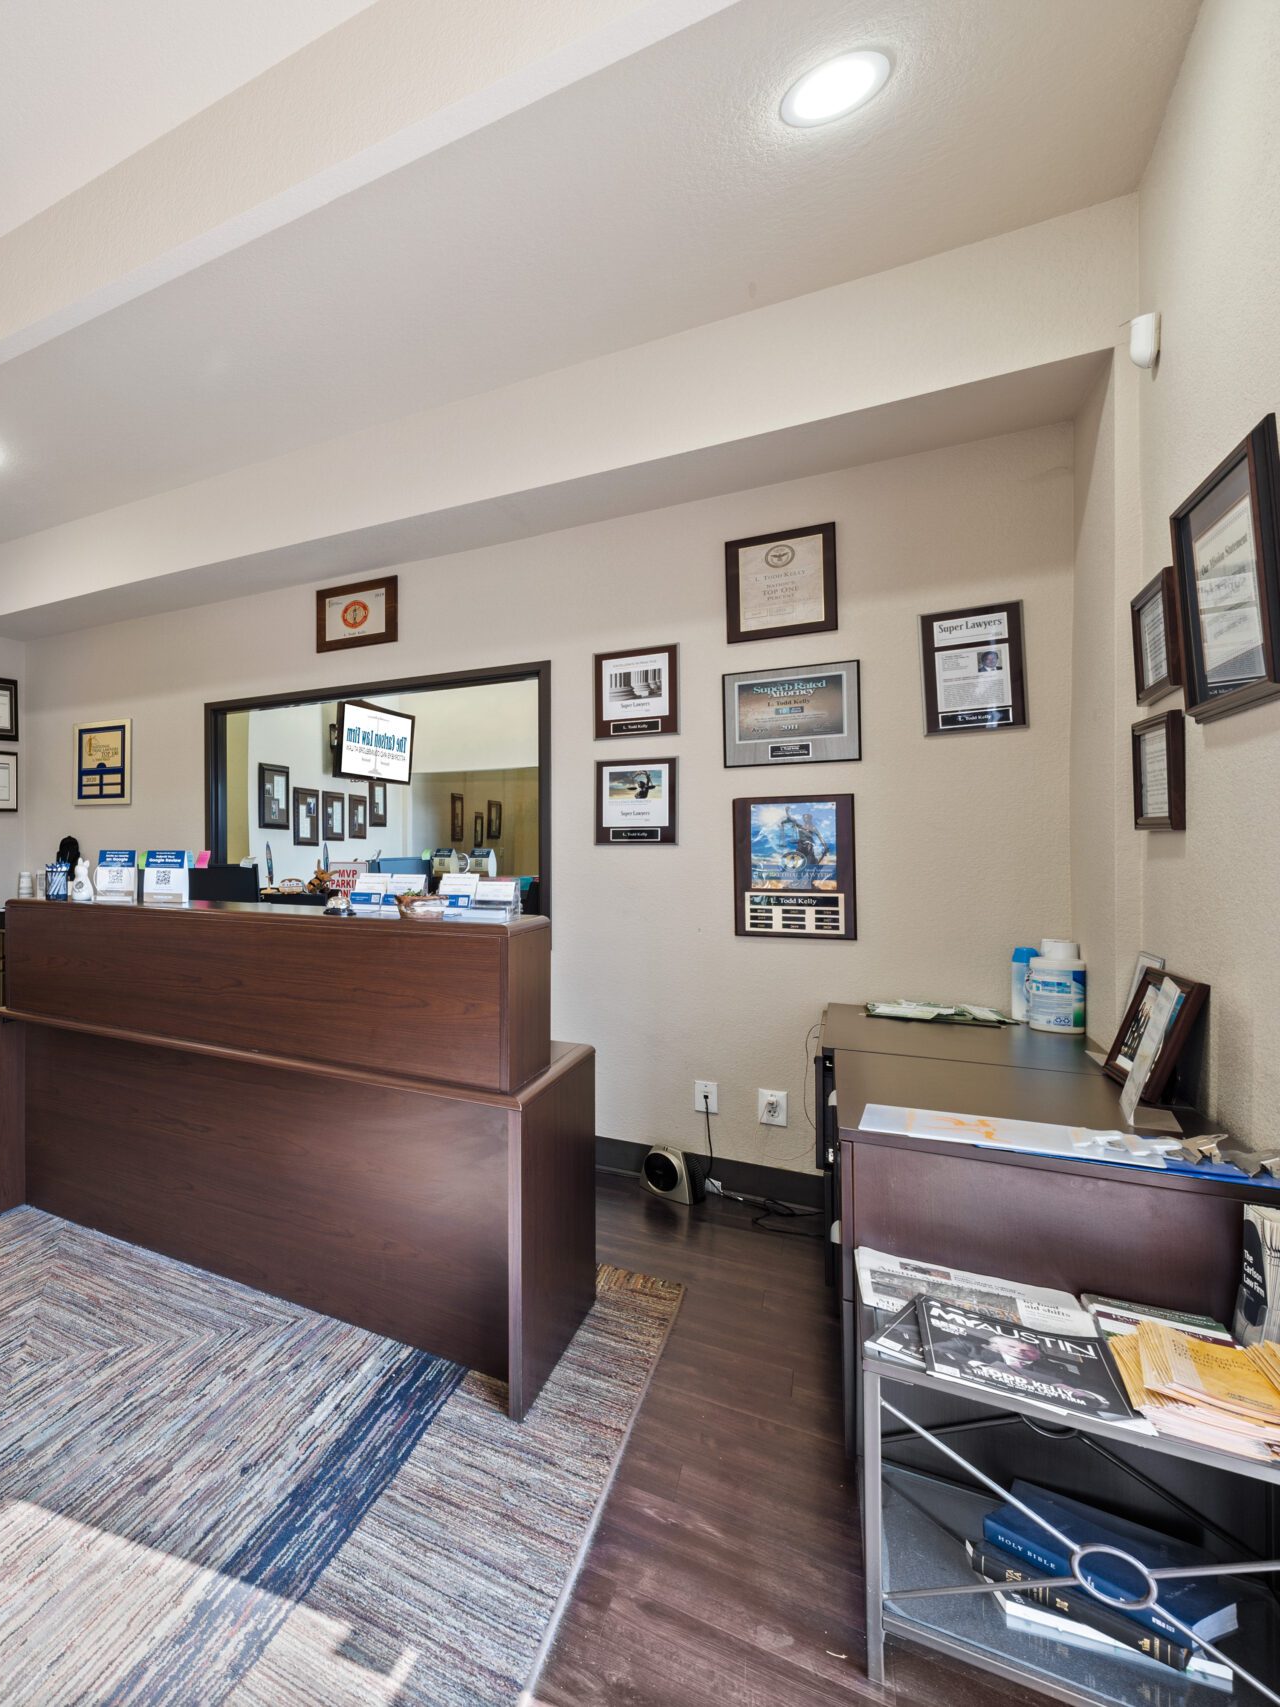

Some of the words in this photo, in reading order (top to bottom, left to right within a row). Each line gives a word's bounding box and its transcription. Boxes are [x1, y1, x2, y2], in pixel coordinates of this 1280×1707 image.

[1200, 562, 1209, 577] Our
[1209, 551, 1225, 569] Mission
[1224, 532, 1249, 556] Statement
[762, 588, 778, 596] TOP
[780, 585, 799, 593] ONE
[938, 622, 964, 634] Super
[965, 618, 1002, 630] Lawyers
[752, 683, 793, 694] Superb
[794, 680, 826, 690] Rated
[769, 688, 815, 698] Attorney
[338, 869, 357, 878] MVP
[331, 879, 357, 888] PARKI
[1243, 1249, 1253, 1263] The
[1243, 1262, 1263, 1283] Carlson
[1243, 1273, 1254, 1288] Law
[1253, 1281, 1265, 1297] Firm
[973, 1368, 986, 1377] THE
[992, 1376, 1035, 1391] CARLSON
[1036, 1387, 1059, 1397] LAW
[1061, 1393, 1087, 1406] FIRM
[981, 1366, 1028, 1384] TODD
[1031, 1379, 1076, 1397] KELLY
[997, 1535, 1024, 1552] HOLY
[1027, 1550, 1056, 1570] BIBLE
